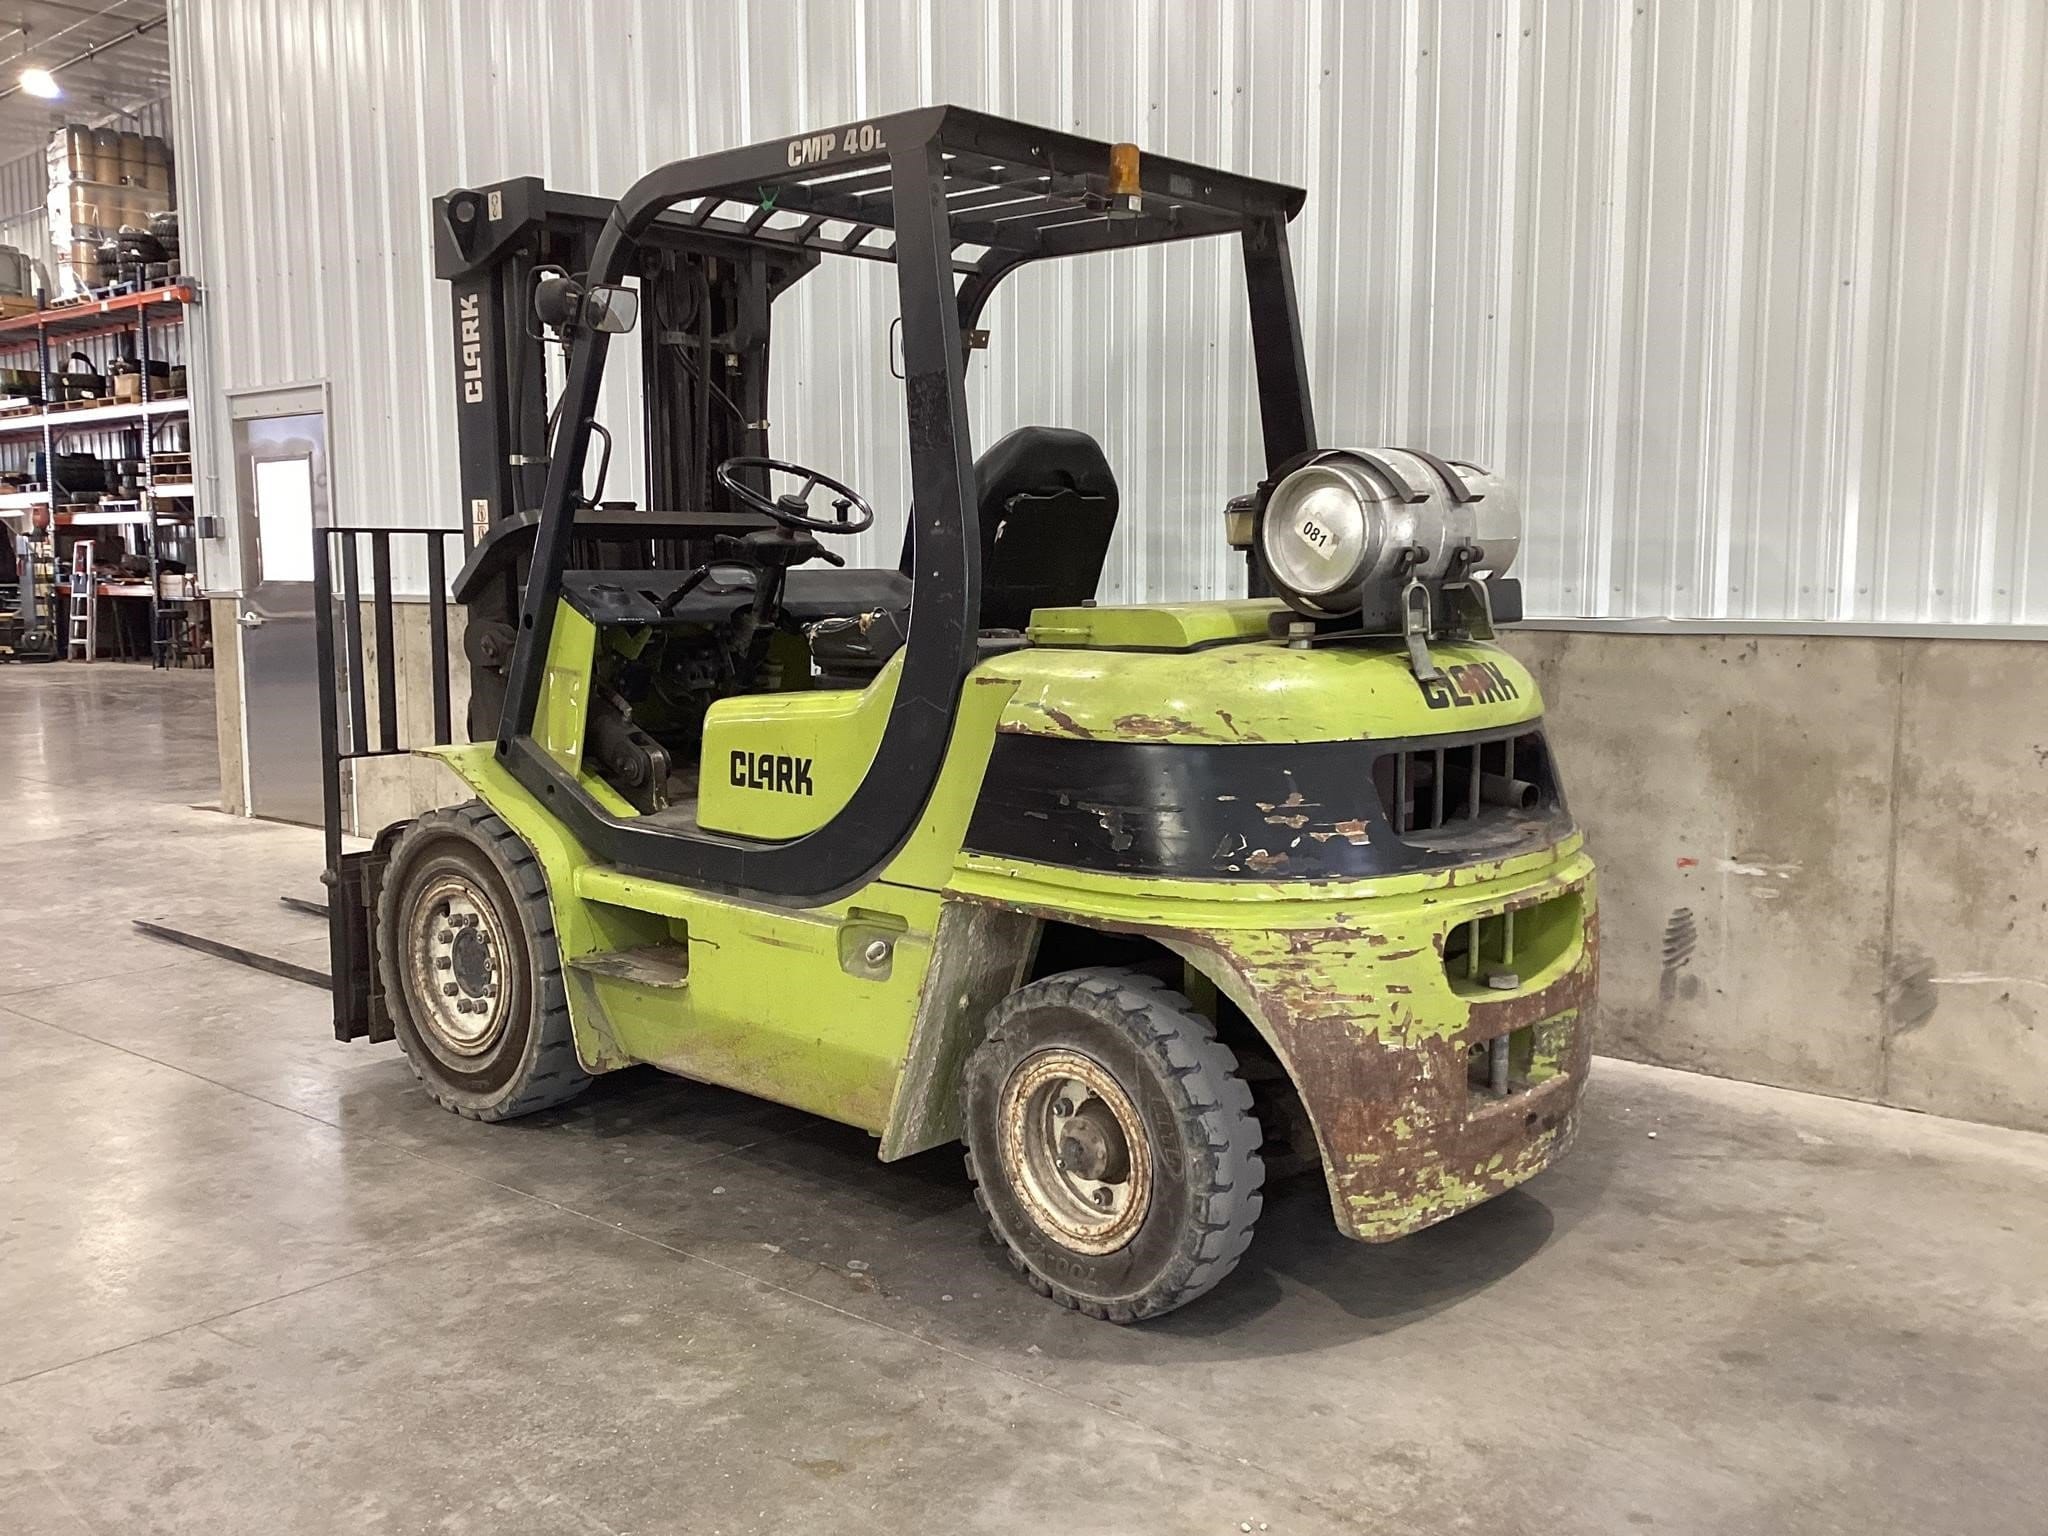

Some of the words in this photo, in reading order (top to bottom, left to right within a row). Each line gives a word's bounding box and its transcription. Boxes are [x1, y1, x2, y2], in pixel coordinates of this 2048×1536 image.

[787, 133, 836, 168] CMP
[460, 293, 483, 404] CLARK
[1303, 521, 1328, 547] 081
[730, 750, 813, 796] CLARK
